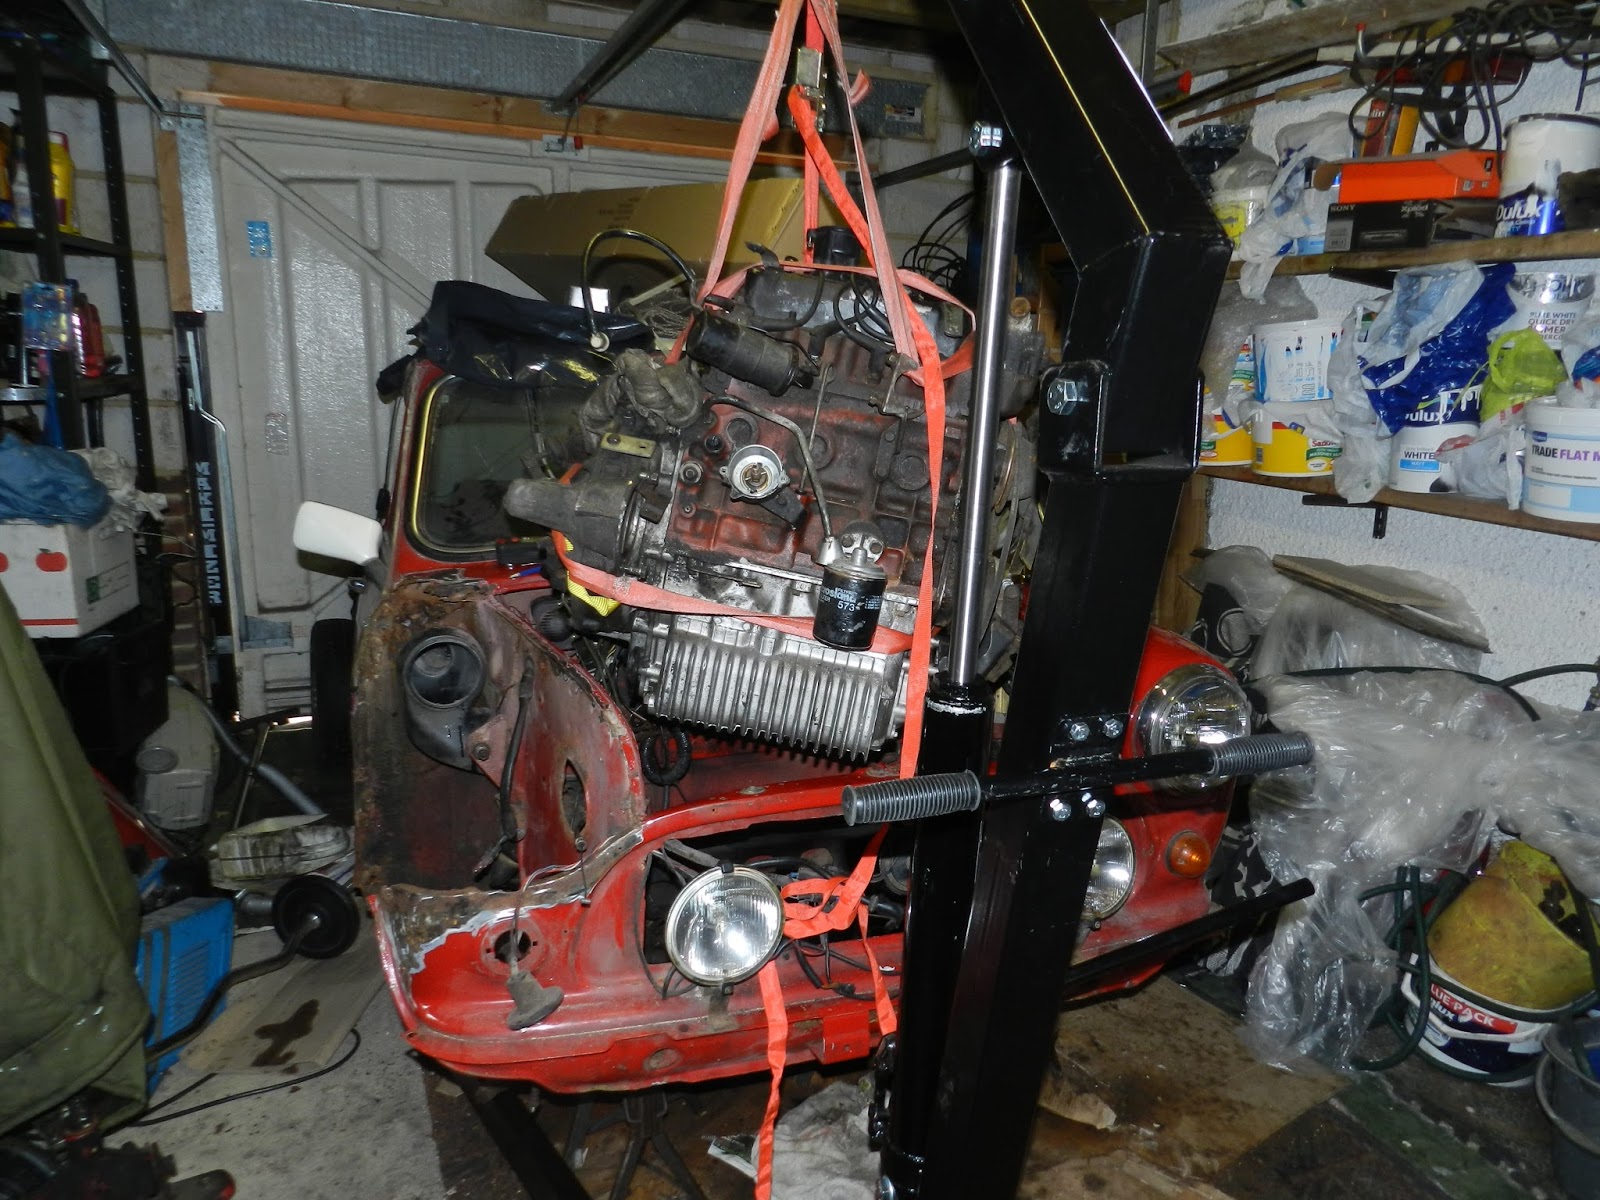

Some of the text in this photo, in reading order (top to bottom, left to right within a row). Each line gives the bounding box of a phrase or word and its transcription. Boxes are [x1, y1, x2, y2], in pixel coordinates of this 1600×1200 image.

[1330, 204, 1356, 212] SONY
[1404, 450, 1435, 459] WHITE
[1532, 444, 1558, 458] TRADE
[1560, 449, 1590, 461] FLAT
[837, 600, 855, 612] 573
[1430, 983, 1495, 1027] LUE PACK
